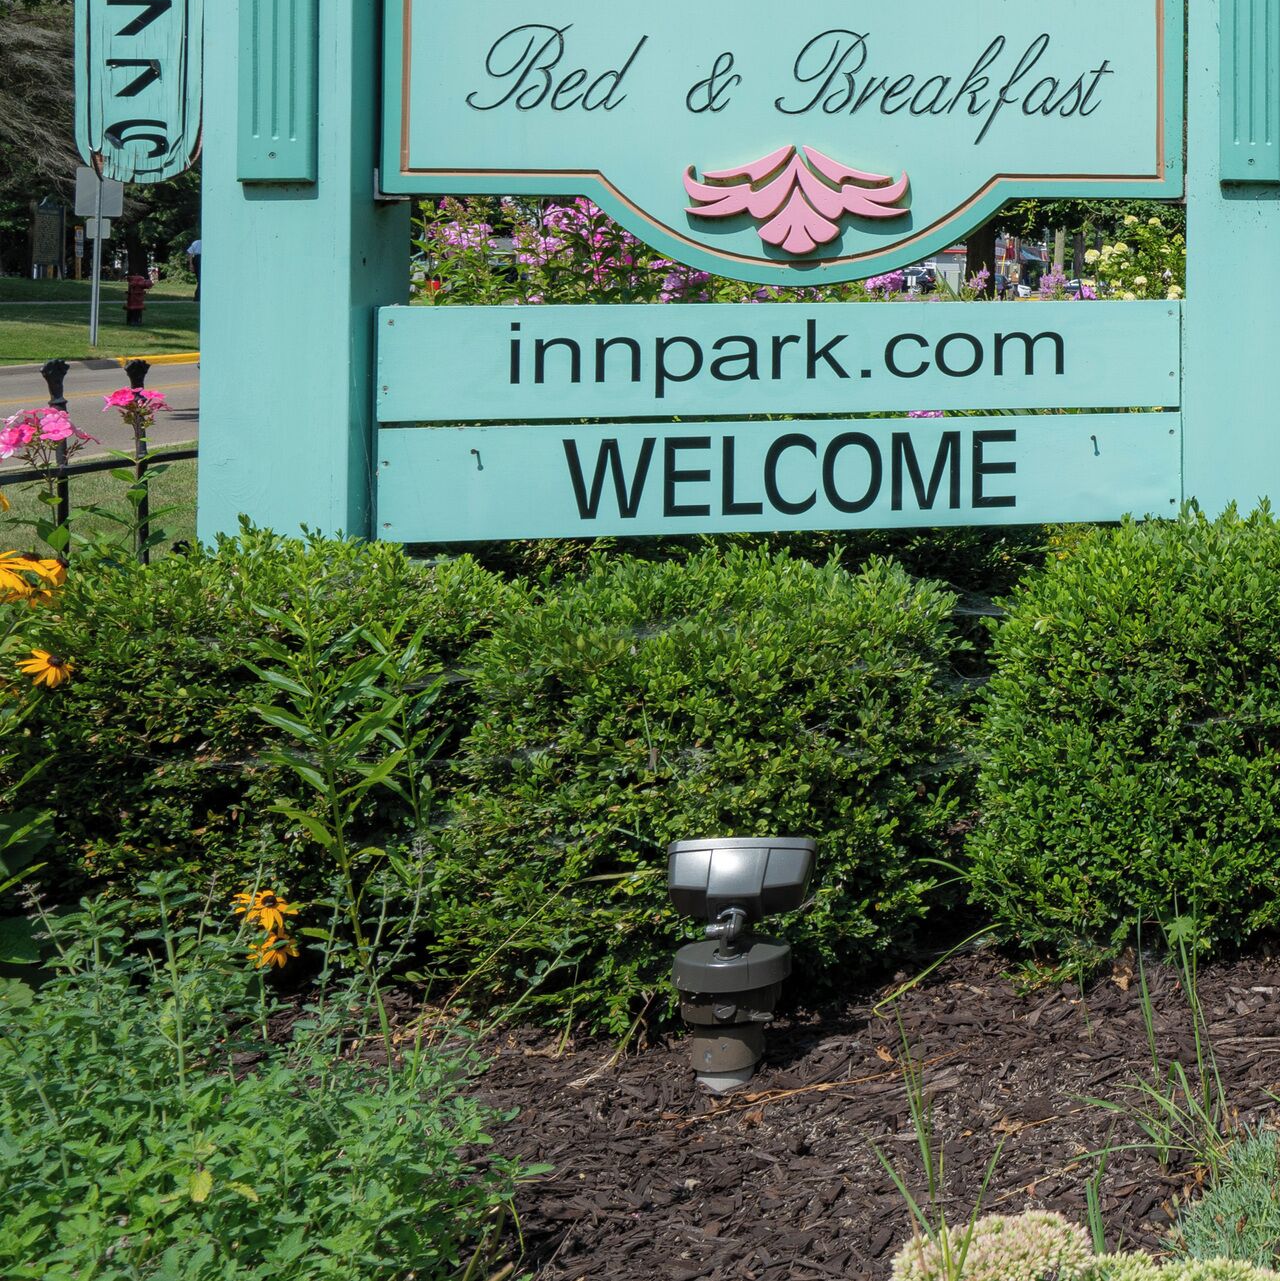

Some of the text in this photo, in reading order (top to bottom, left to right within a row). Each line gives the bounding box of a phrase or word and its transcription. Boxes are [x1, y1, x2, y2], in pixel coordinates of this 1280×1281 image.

[466, 23, 1114, 145] Bed & Breakfast
[510, 318, 1066, 399] innpark.com
[563, 429, 1018, 520] WELCOME
